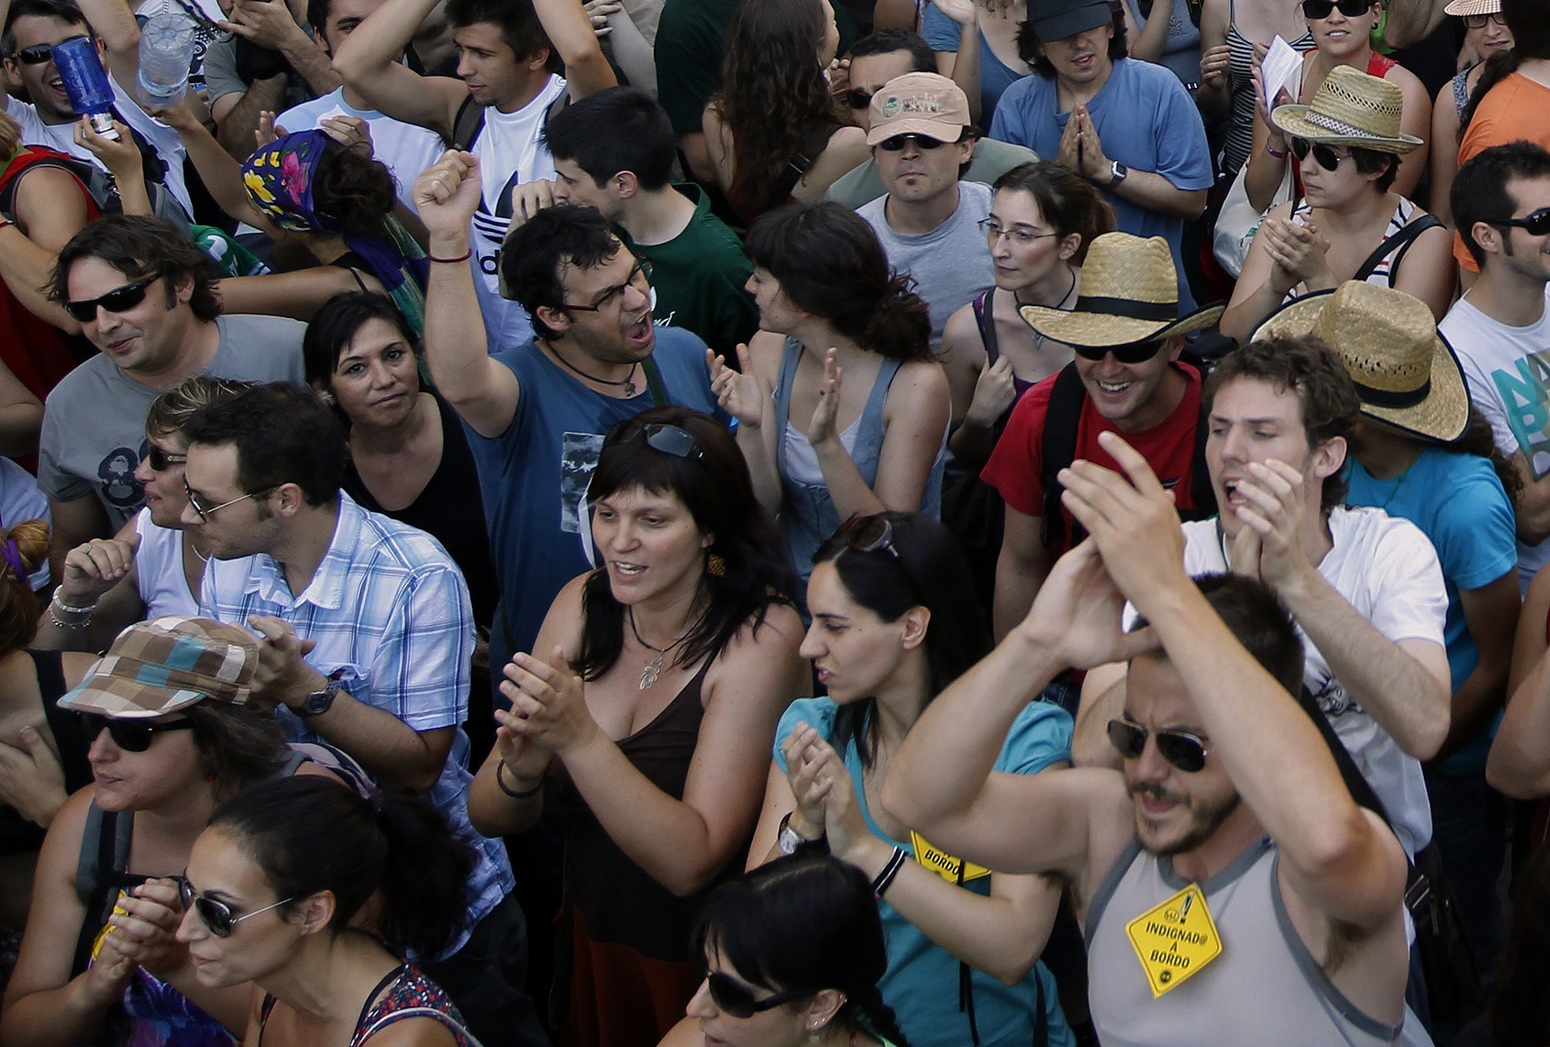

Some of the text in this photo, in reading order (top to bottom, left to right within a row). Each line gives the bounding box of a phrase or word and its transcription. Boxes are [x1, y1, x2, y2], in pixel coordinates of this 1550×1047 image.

[924, 849, 961, 876] BORDO
[1169, 941, 1178, 953] A
[1149, 950, 1191, 969] BORDO
